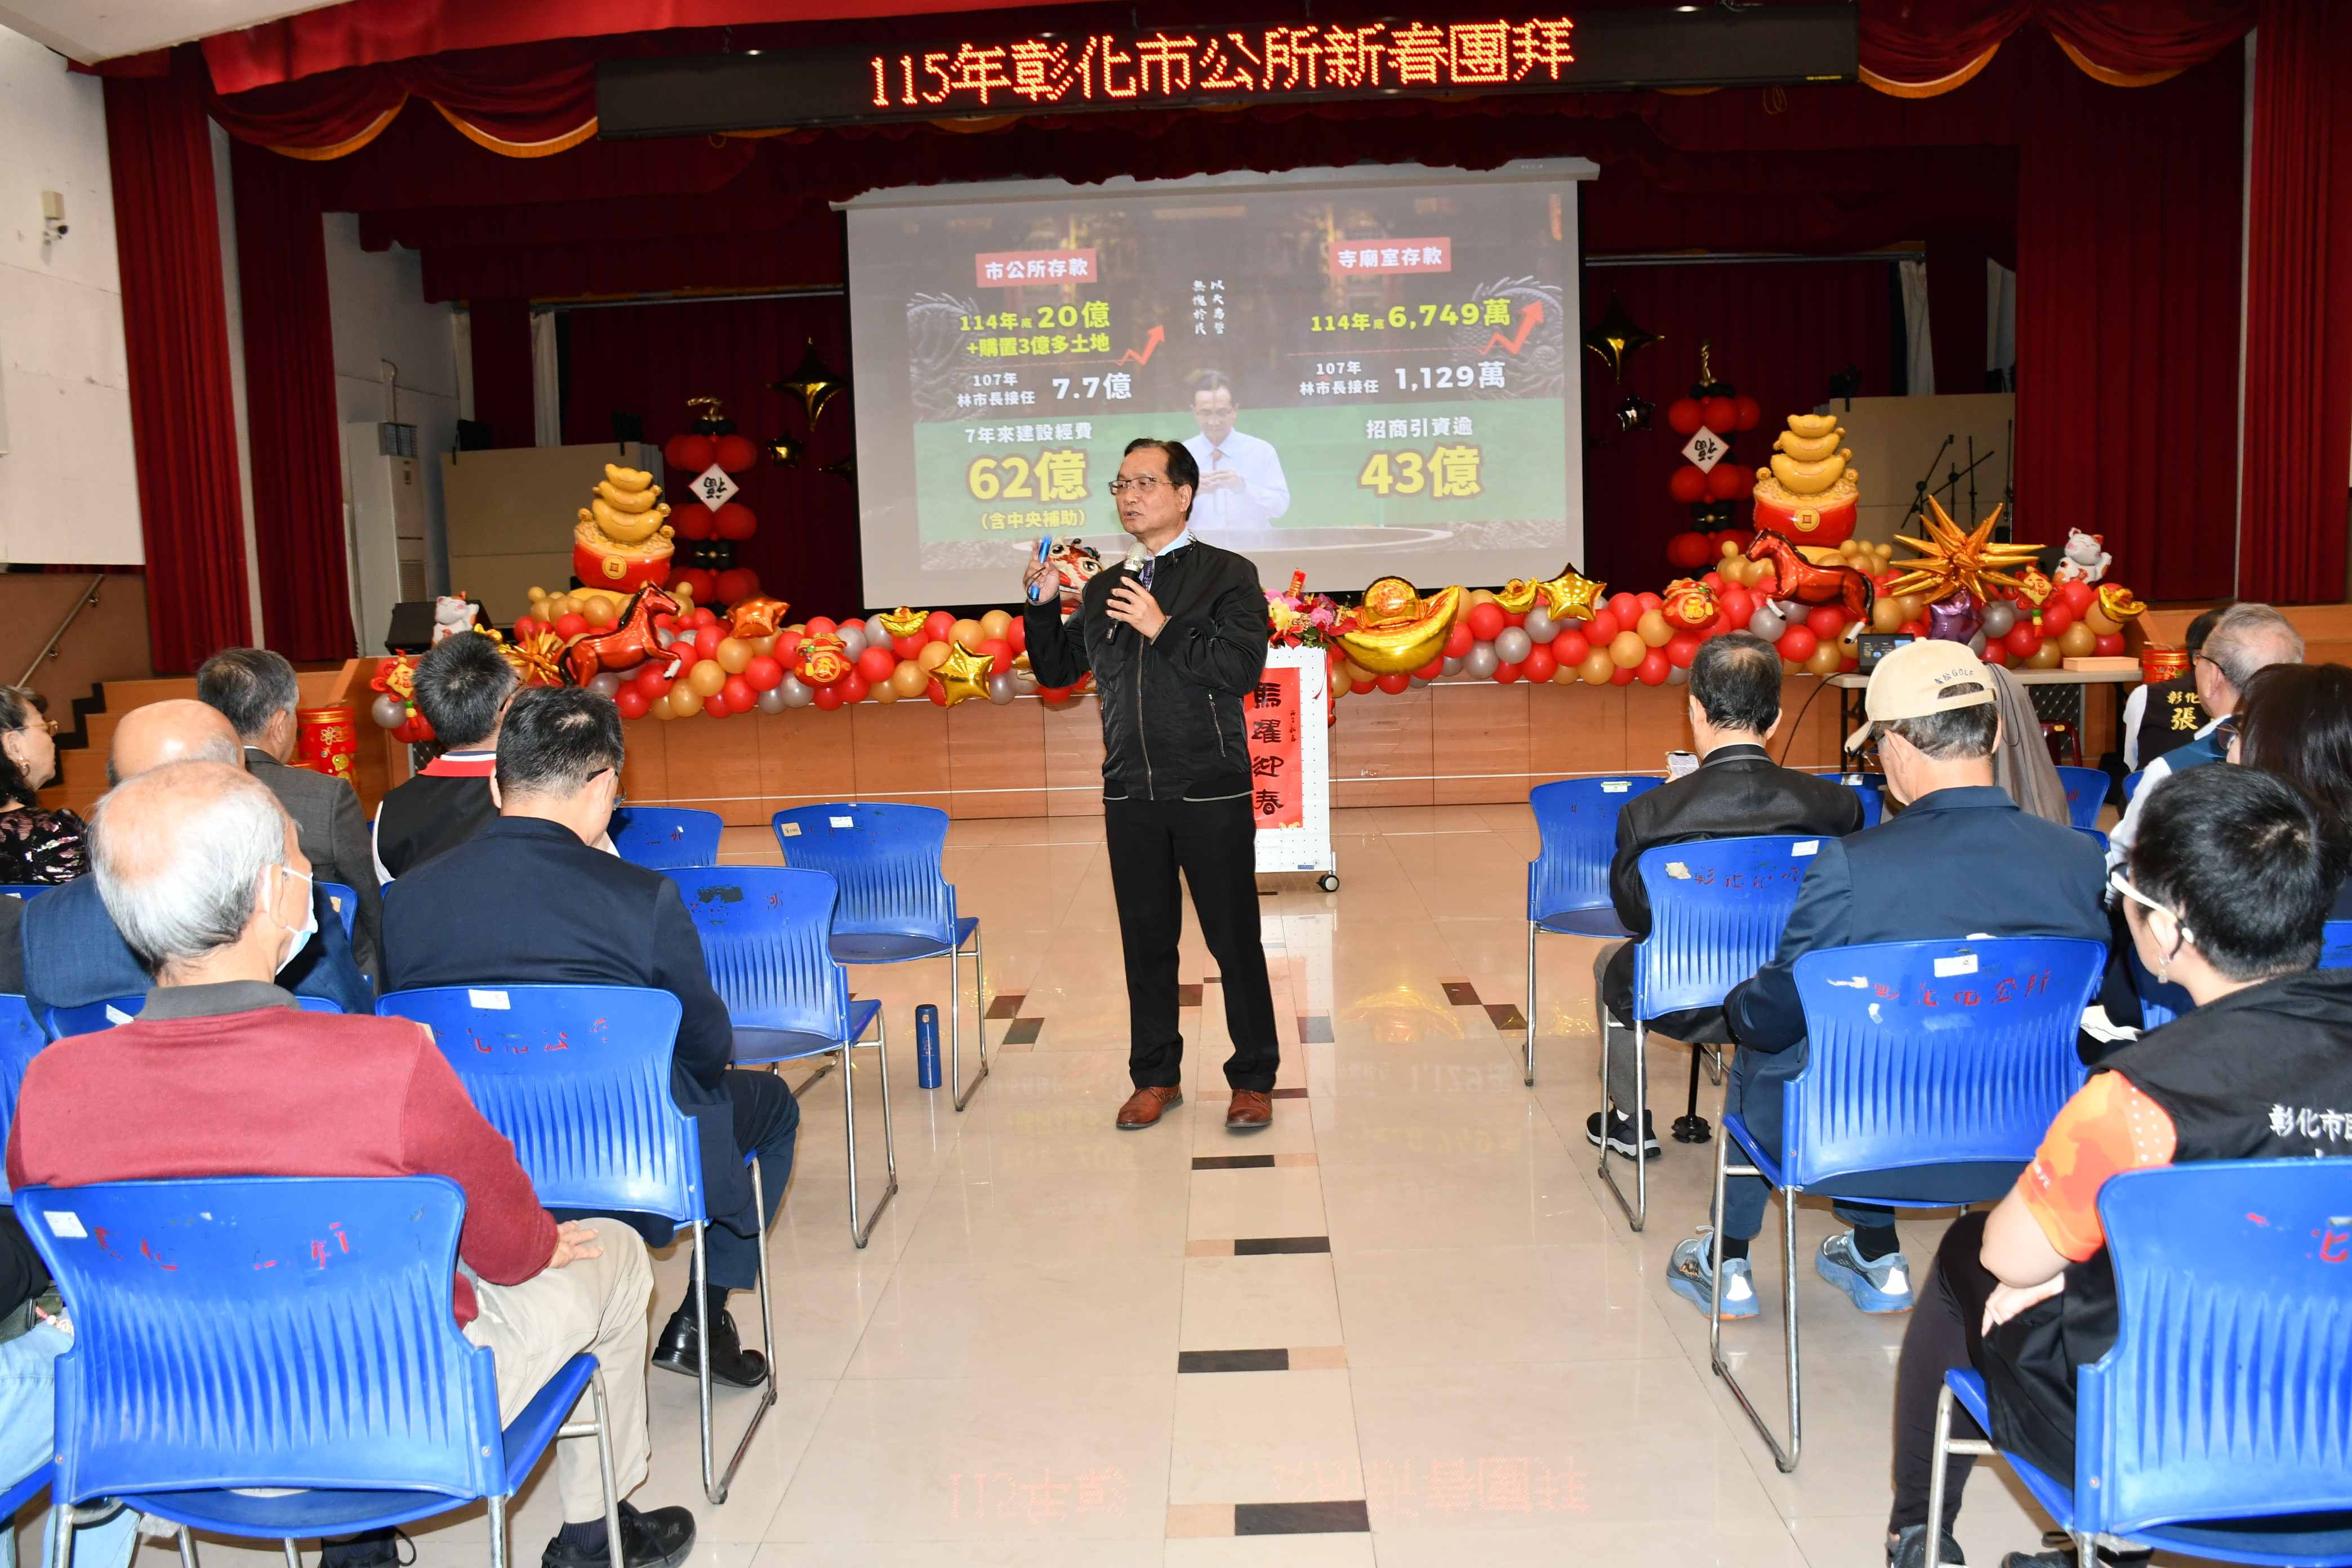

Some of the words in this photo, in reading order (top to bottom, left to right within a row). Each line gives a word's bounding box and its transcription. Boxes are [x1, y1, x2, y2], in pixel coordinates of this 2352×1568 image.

[871, 17, 1575, 107] 115年彰化市公所新春團拜
[985, 257, 1089, 280] 市公所存款
[1338, 246, 1442, 269] 寺廟室存款
[967, 333, 1110, 357] +購置3億多土地
[973, 372, 1018, 387] 107年
[1316, 360, 1362, 376] 107年
[1395, 360, 1506, 392] 1,129萬
[1052, 372, 1132, 400] 7.7億
[1299, 380, 1379, 397] 林市長接任
[957, 391, 1035, 408] 林市長接任
[964, 422, 1092, 444] 7年來建設經費
[1366, 416, 1473, 439] 招商引資逾
[969, 450, 1088, 501] 62億
[1361, 445, 1481, 498] 43億
